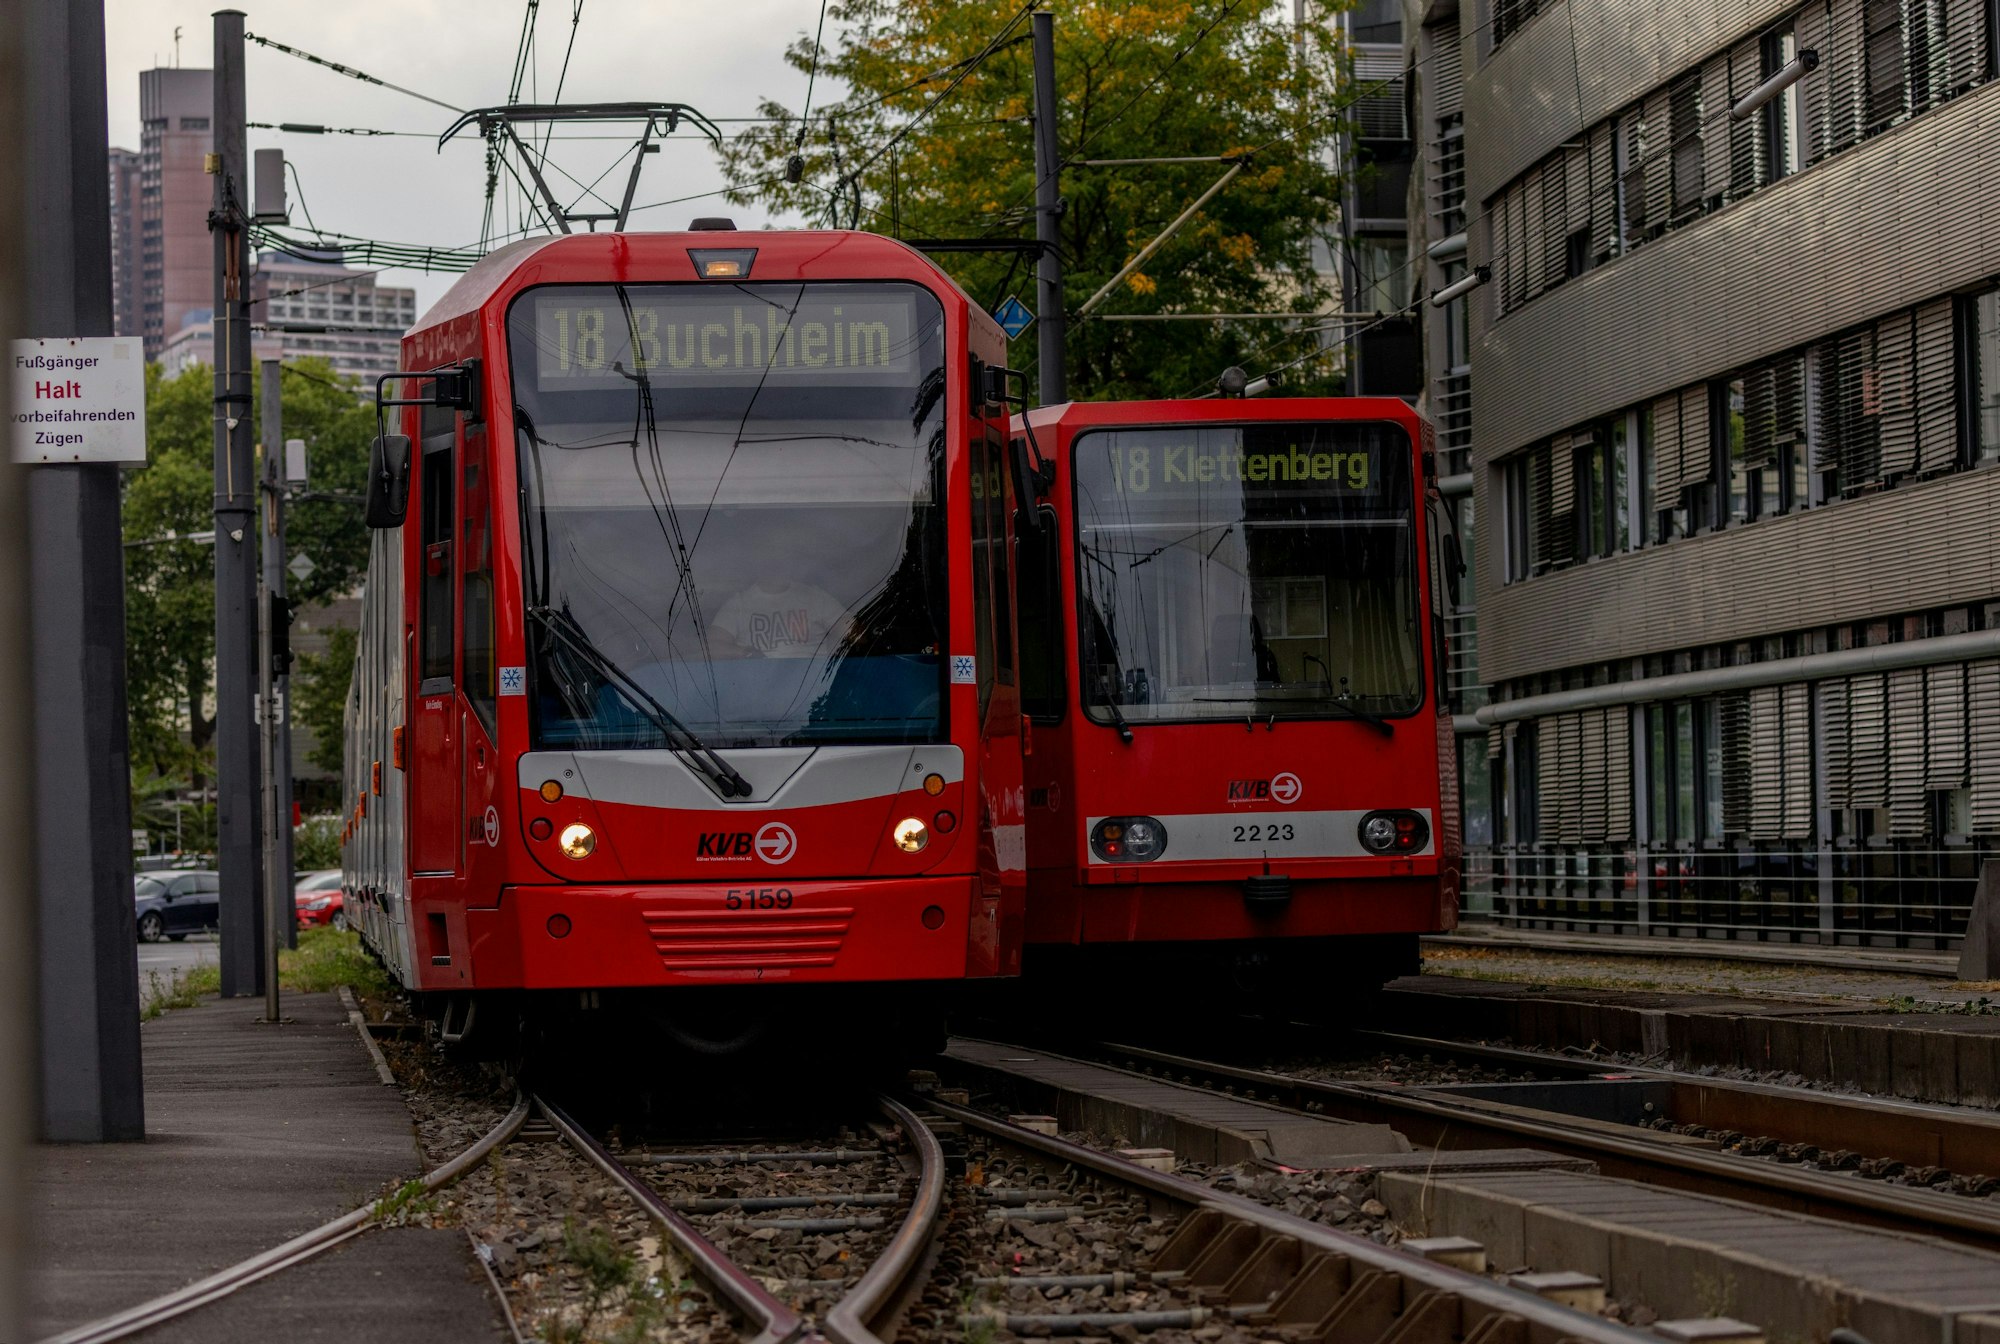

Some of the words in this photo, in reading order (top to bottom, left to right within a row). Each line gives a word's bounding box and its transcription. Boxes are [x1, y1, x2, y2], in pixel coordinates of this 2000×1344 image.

[554, 307, 605, 371] 18
[630, 306, 890, 369] Buchheim
[15, 355, 99, 371] Fußgänger
[35, 380, 82, 399] Halt
[35, 431, 83, 447] Zügen
[1112, 445, 1150, 493] 18
[1163, 444, 1369, 489] Klettenberg
[1228, 780, 1270, 799] KVB
[697, 832, 753, 856] KVB
[725, 888, 794, 911] 5159
